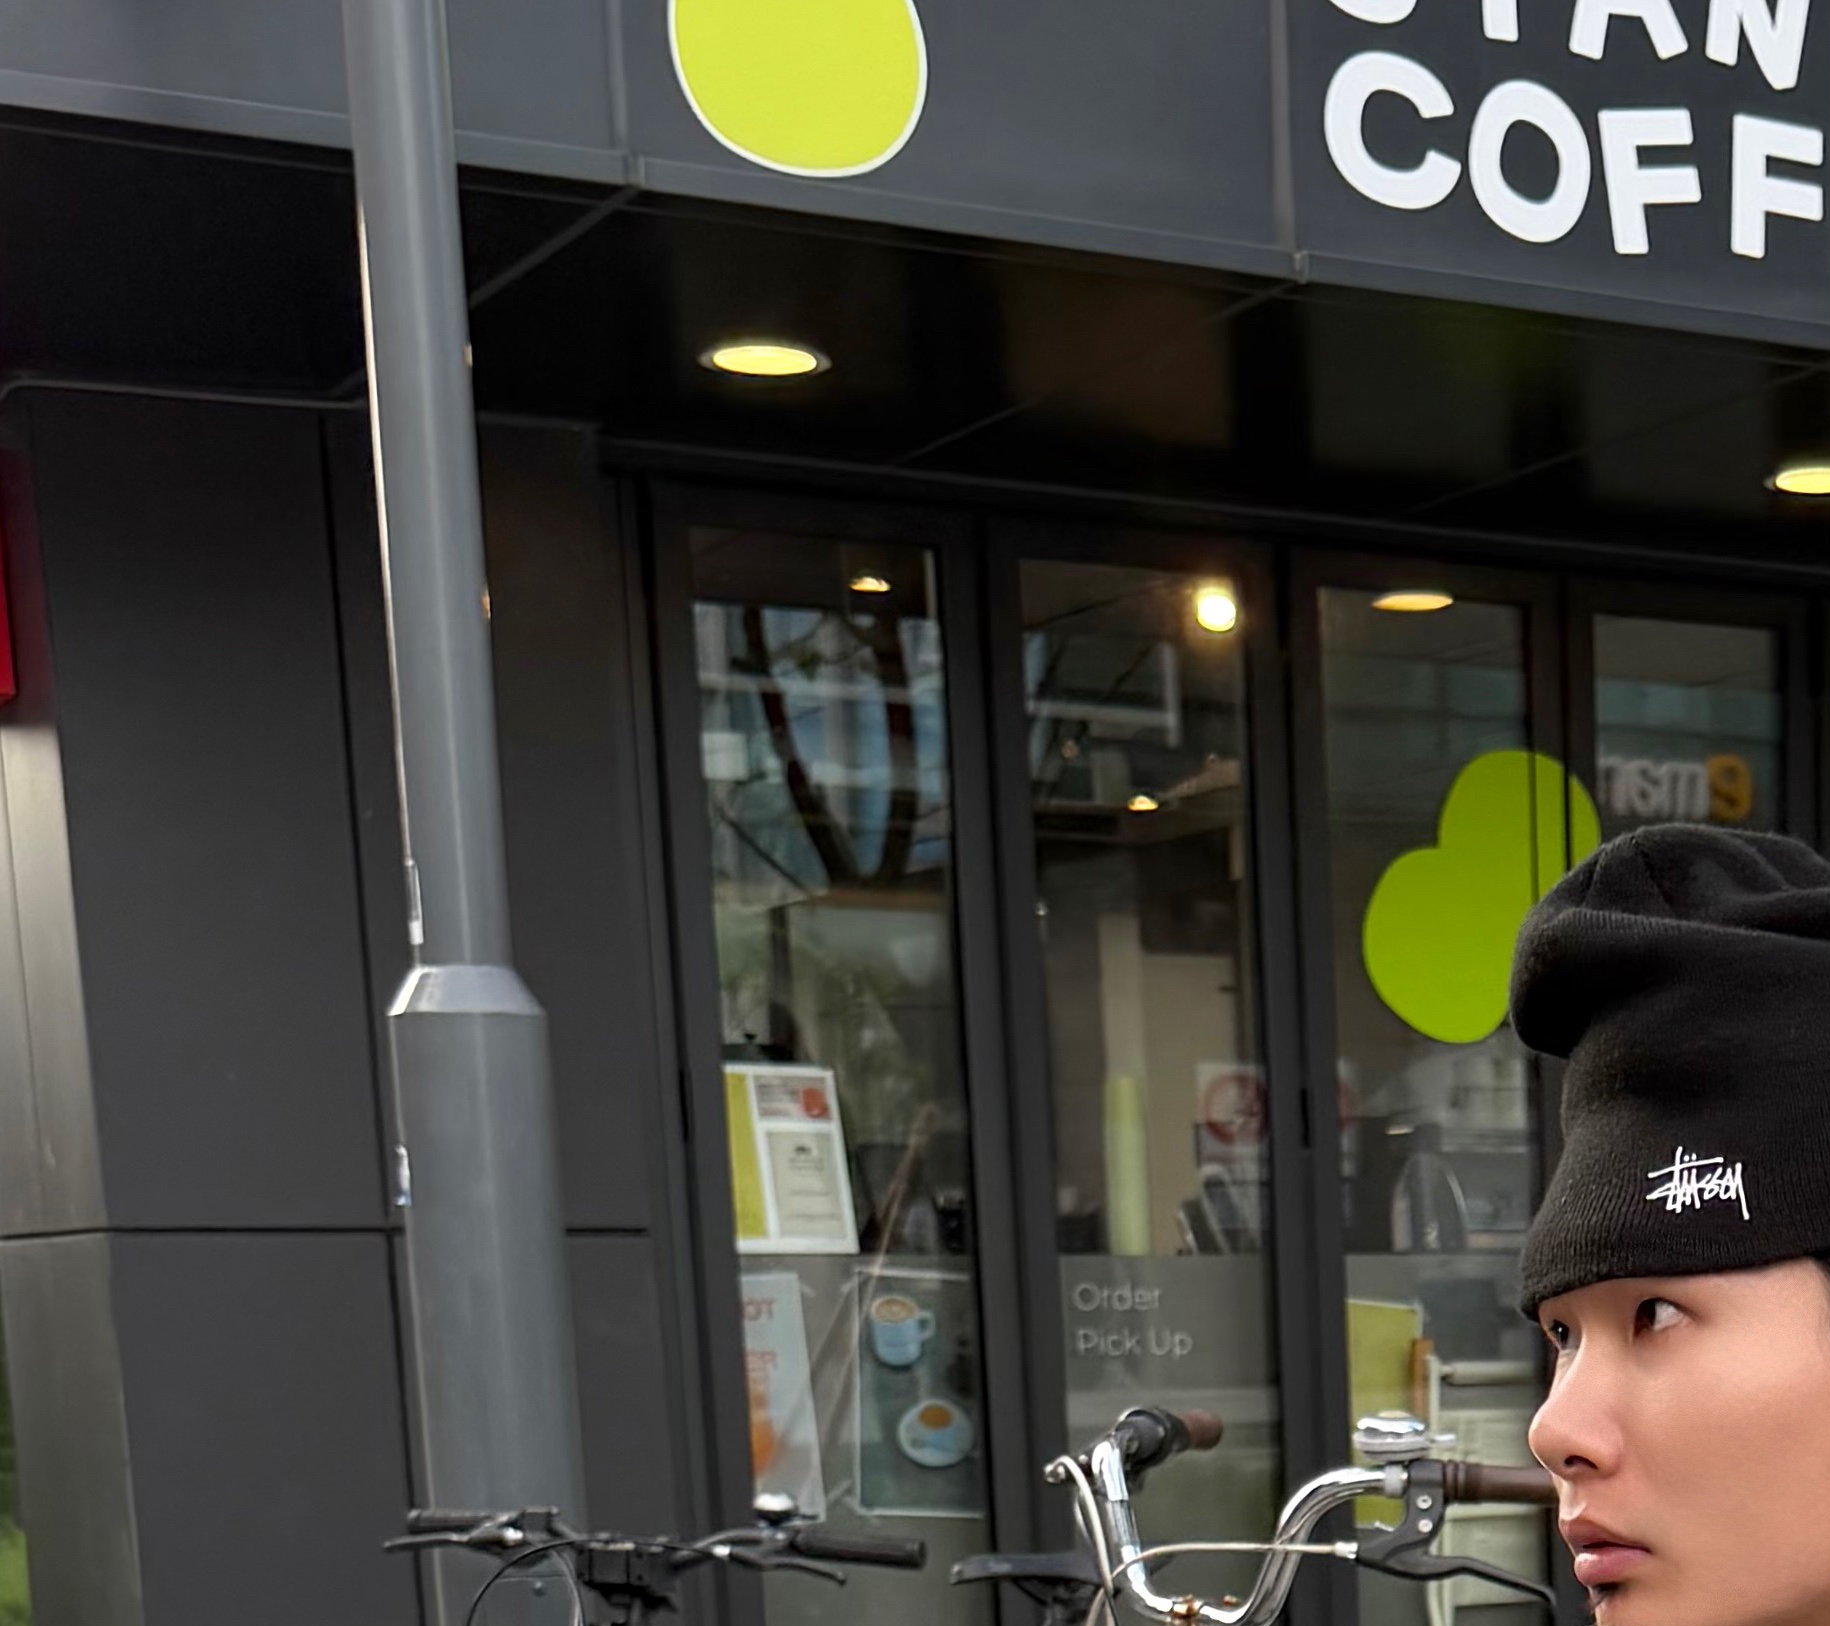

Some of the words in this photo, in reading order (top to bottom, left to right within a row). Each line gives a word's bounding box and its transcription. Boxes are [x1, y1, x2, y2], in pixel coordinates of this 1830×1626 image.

[1073, 1281, 1162, 1312] Order
[1077, 1328, 1140, 1357] Pick
[1149, 1328, 1193, 1359] Up
